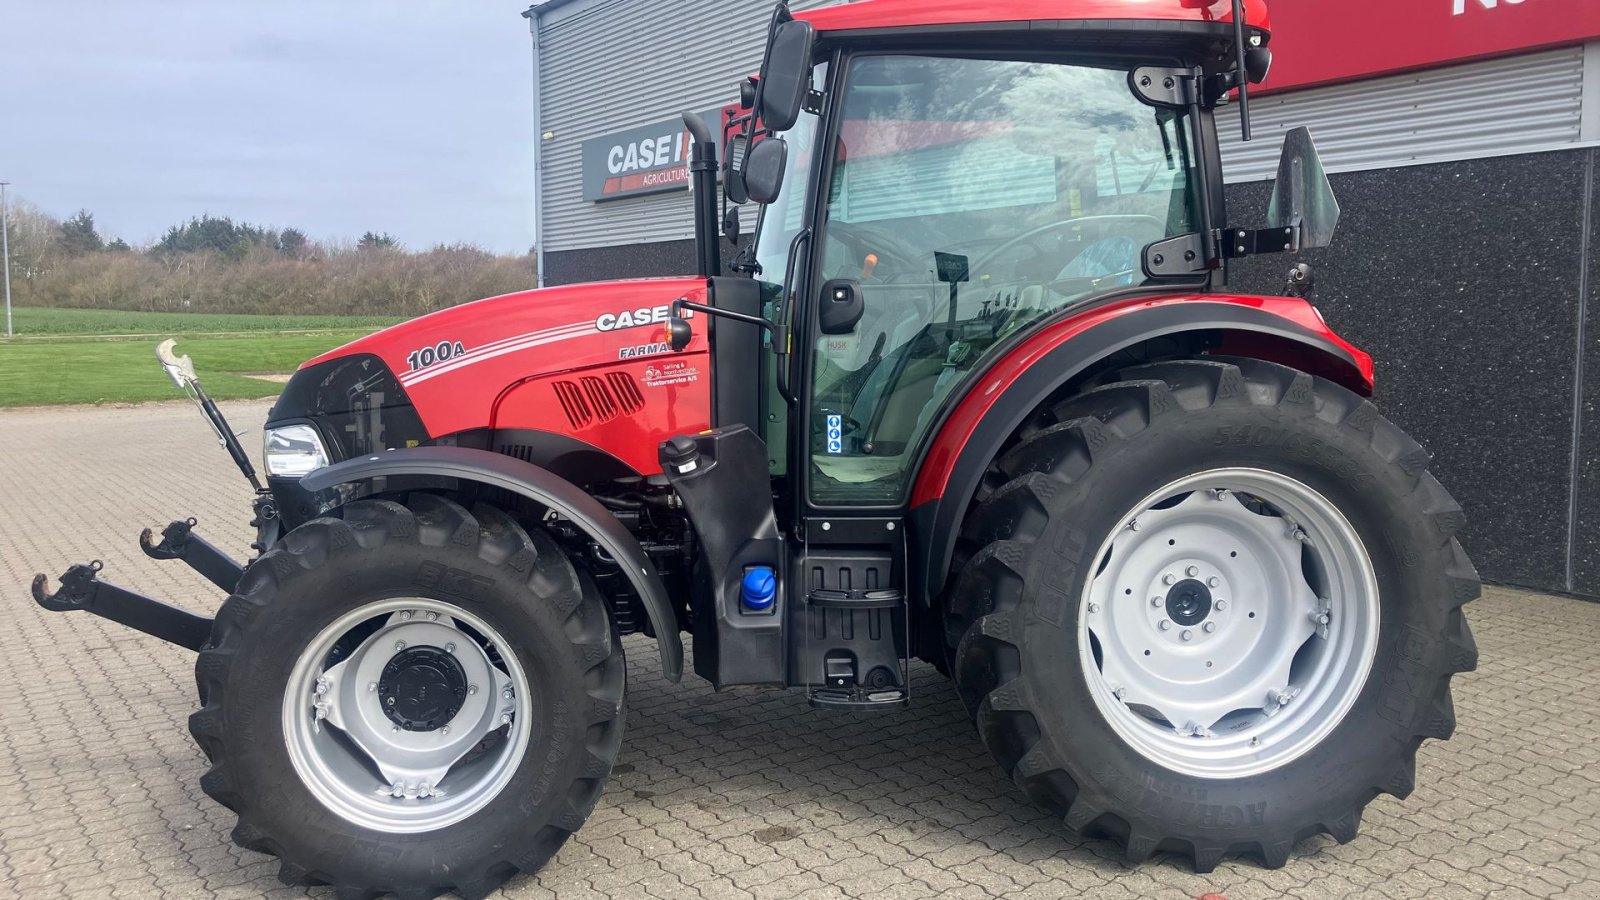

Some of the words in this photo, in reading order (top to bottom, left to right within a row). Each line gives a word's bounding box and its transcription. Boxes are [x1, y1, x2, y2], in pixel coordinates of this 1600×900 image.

[607, 134, 672, 174] CASE
[643, 168, 689, 186] AGRICULTURE
[596, 305, 670, 332] CASE
[619, 342, 668, 359] FARMA
[827, 341, 847, 349] HUSK
[406, 340, 466, 372] 100A
[646, 377, 687, 387] Traktorservice
